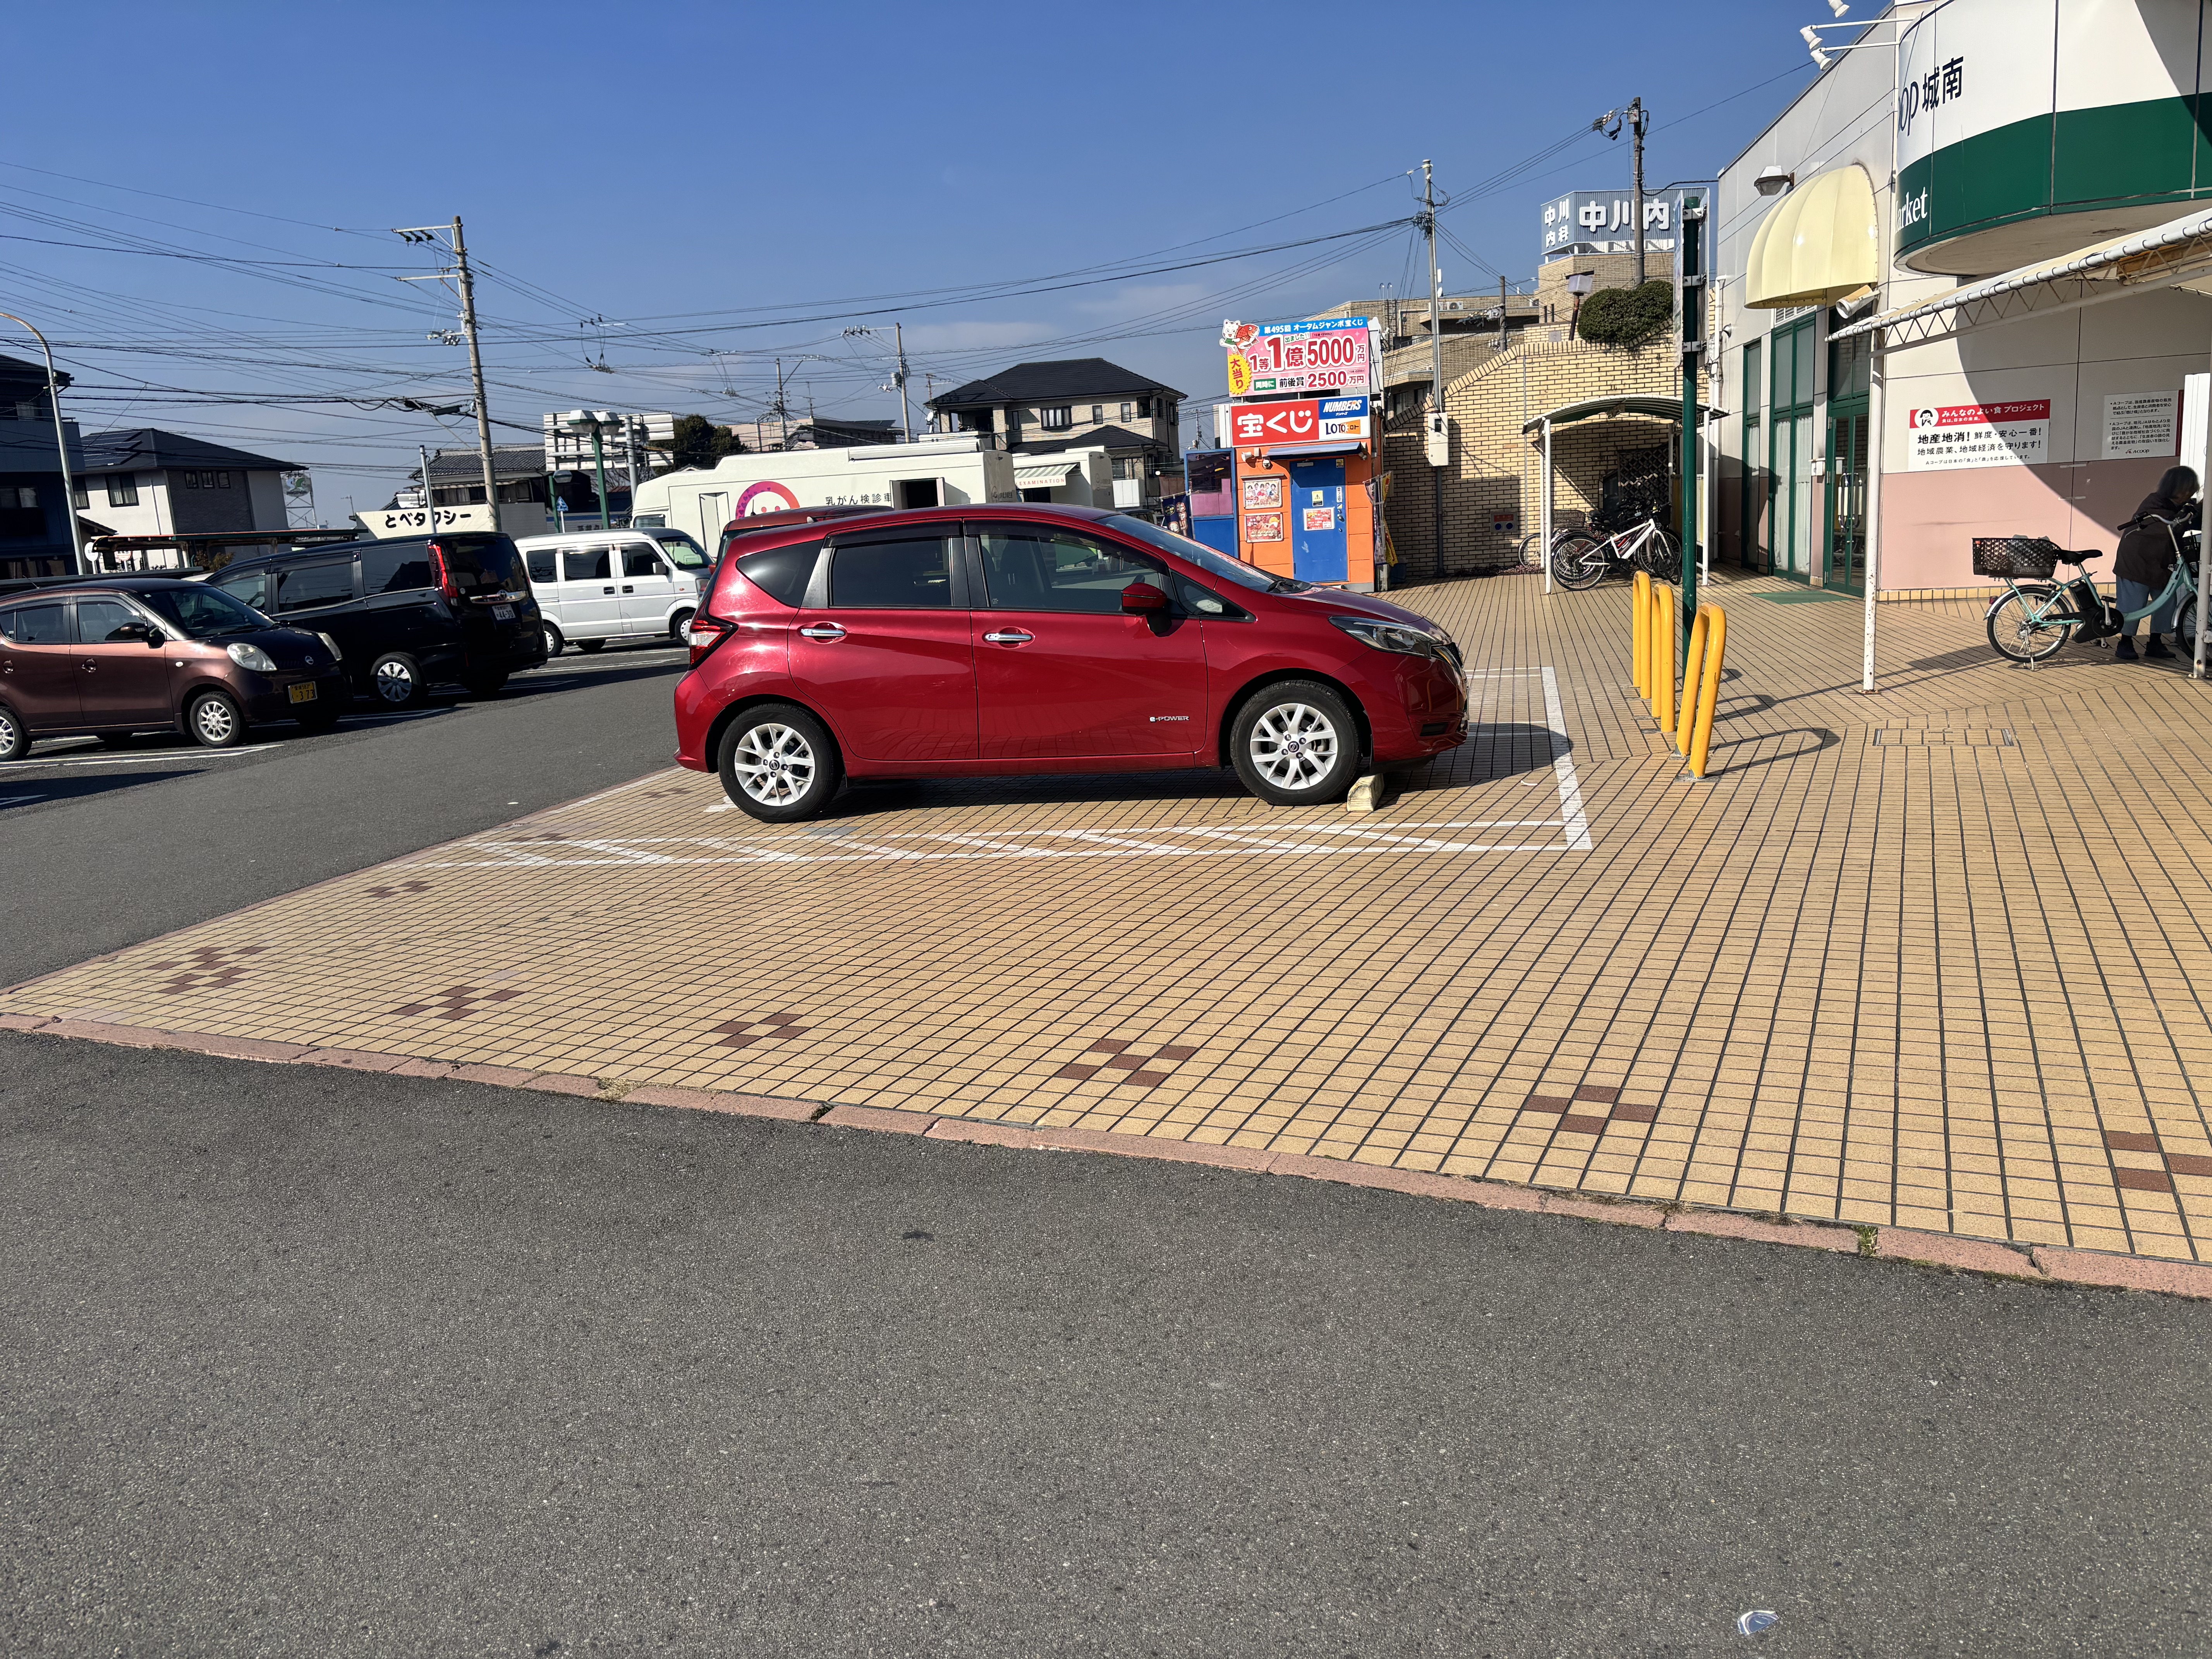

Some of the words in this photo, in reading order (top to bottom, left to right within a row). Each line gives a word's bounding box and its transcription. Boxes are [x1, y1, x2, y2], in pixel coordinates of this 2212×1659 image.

[1922, 55, 1964, 113] 城南
[1544, 198, 1569, 227] 中川
[1546, 225, 1568, 248] 内科
[1264, 325, 1291, 334] 第495回
[1293, 319, 1363, 331] オータムジャンボ宝くじ
[1230, 358, 1244, 389] 大当り
[1255, 380, 1274, 388] 同時に
[1279, 377, 1304, 388] 前後賞
[1323, 399, 1362, 412] NUMBERS
[1942, 406, 2001, 417] みんなのよい食
[2004, 404, 2044, 413] プロジェクト
[1237, 410, 1313, 438] 宝くじ
[1325, 423, 1346, 435] LOTO
[1917, 431, 1970, 444] 地産地消!
[825, 493, 891, 506] 乳がん検診車
